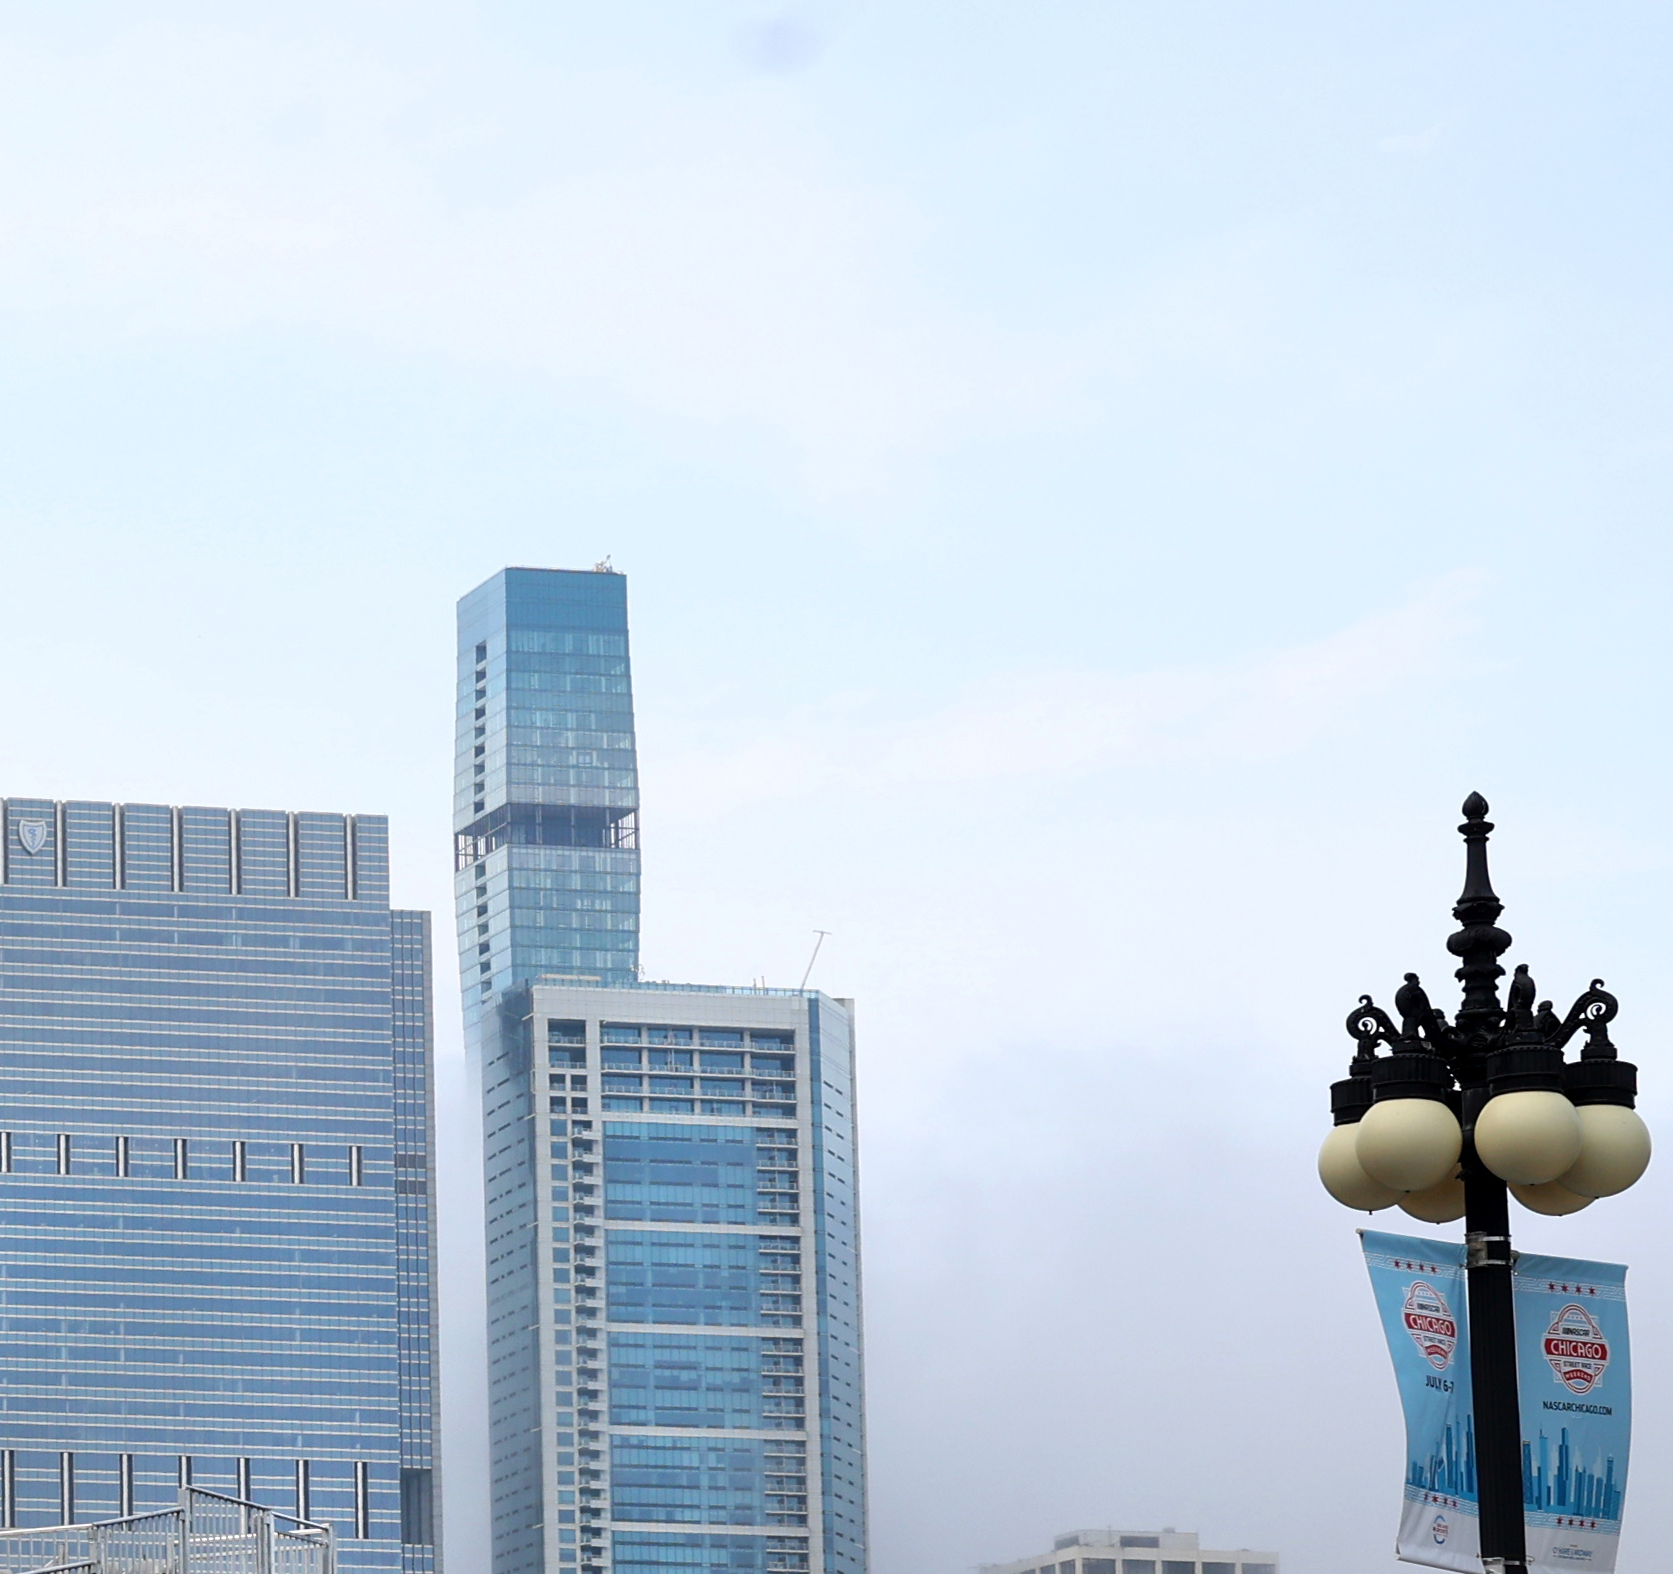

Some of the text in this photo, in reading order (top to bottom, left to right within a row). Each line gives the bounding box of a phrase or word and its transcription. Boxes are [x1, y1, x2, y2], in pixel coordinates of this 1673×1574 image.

[1410, 1315, 1452, 1335] CHICAGO
[1566, 1328, 1590, 1336] NASCAR
[1550, 1340, 1602, 1358] CHICAGO
[1425, 1375, 1454, 1393] JULY 6-7
[1565, 1371, 1591, 1381] WEEKEND
[1542, 1400, 1613, 1416] NASCARCHICAGO.COM
